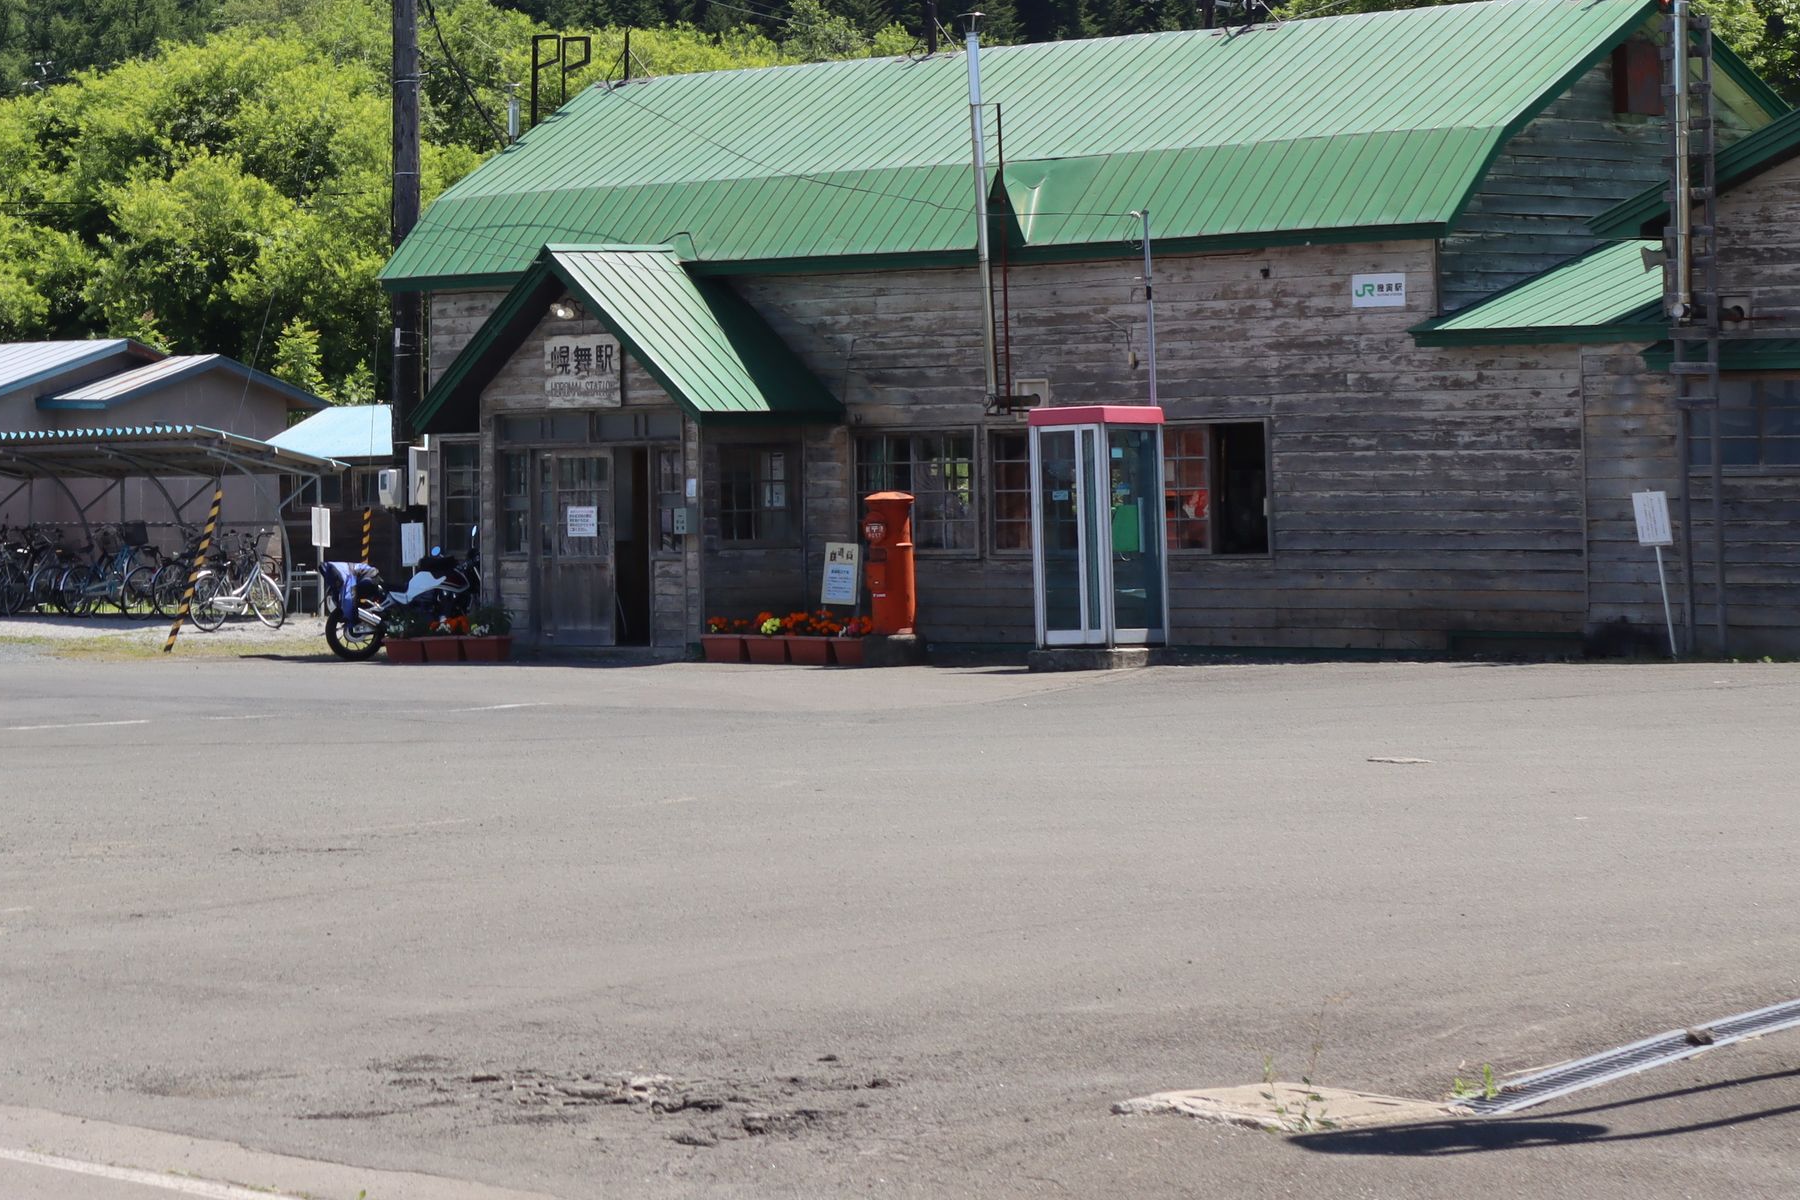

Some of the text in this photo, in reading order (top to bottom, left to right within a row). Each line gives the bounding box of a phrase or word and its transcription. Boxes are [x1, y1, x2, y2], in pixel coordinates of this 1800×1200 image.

[1355, 283, 1375, 298] JR
[551, 344, 614, 377] 幌舞駅
